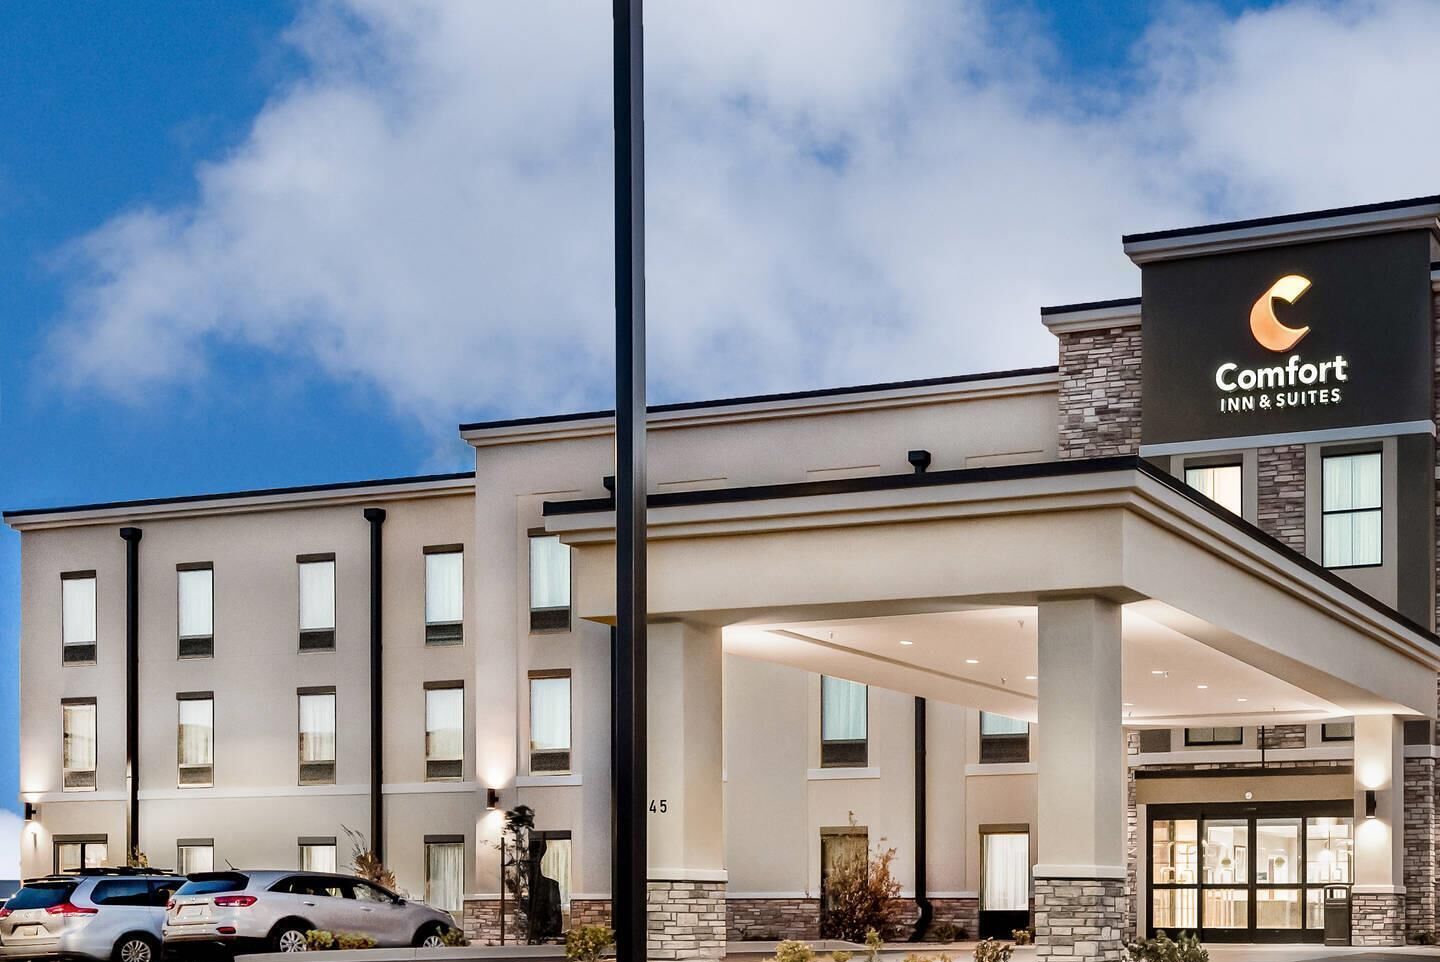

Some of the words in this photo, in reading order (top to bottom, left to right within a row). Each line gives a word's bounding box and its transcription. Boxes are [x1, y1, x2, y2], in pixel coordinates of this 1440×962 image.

[1215, 355, 1347, 391] Comfort
[1220, 396, 1253, 412] INN
[1259, 394, 1271, 408] &
[1276, 388, 1341, 407] SUITES
